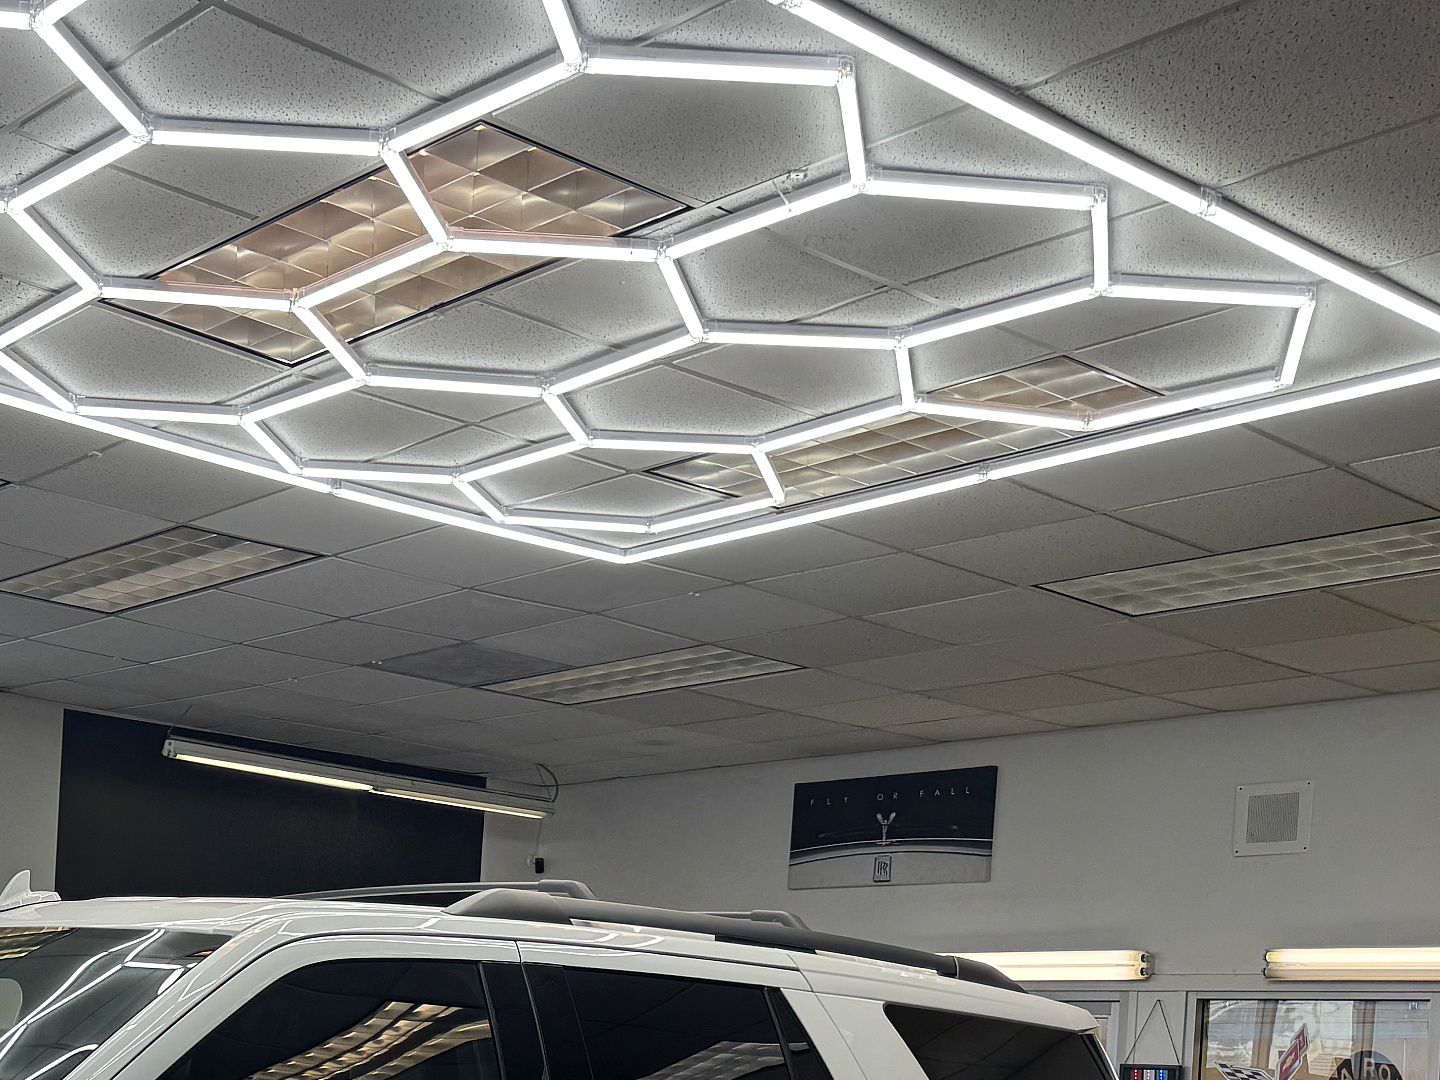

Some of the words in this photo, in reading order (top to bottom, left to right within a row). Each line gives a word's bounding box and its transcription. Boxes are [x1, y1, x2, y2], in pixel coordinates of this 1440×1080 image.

[810, 796, 849, 806] FLY
[876, 792, 899, 801] OR
[919, 786, 971, 798] FALL
